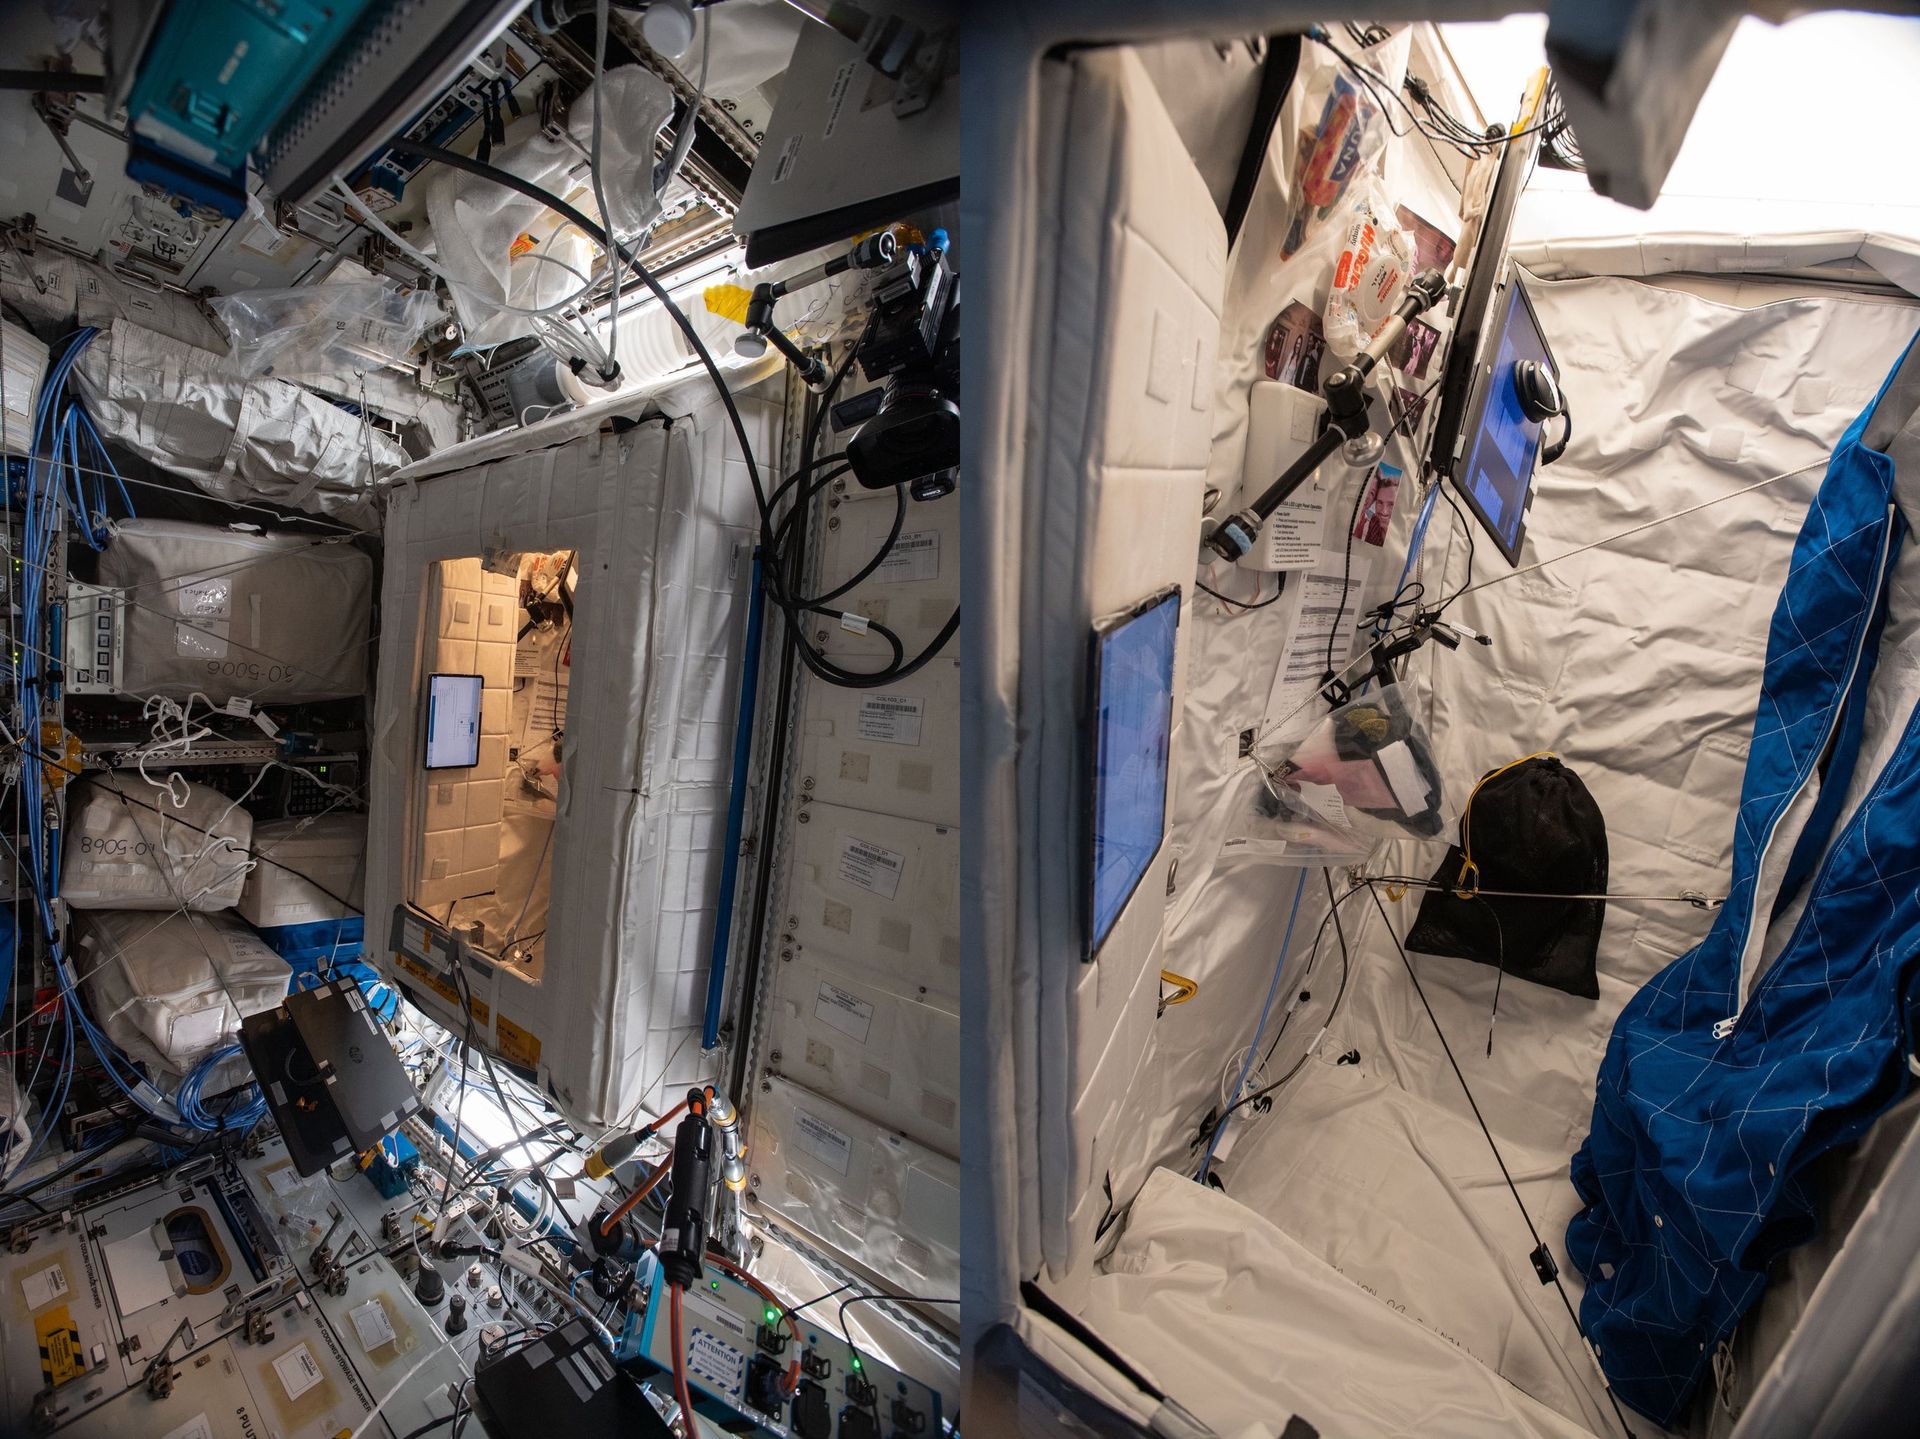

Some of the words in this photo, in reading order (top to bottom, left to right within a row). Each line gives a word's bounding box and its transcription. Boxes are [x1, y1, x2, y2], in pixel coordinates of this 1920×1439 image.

[1336, 129, 1361, 176] UNA
[314, 1317, 323, 1329] HRF
[321, 1328, 338, 1355] COOLING
[335, 1354, 355, 1384] STOWAGE
[352, 1384, 372, 1412] DRAWER
[697, 1338, 737, 1366] ATTENTION
[236, 1406, 245, 1415] 8
[239, 1415, 250, 1429] PU
